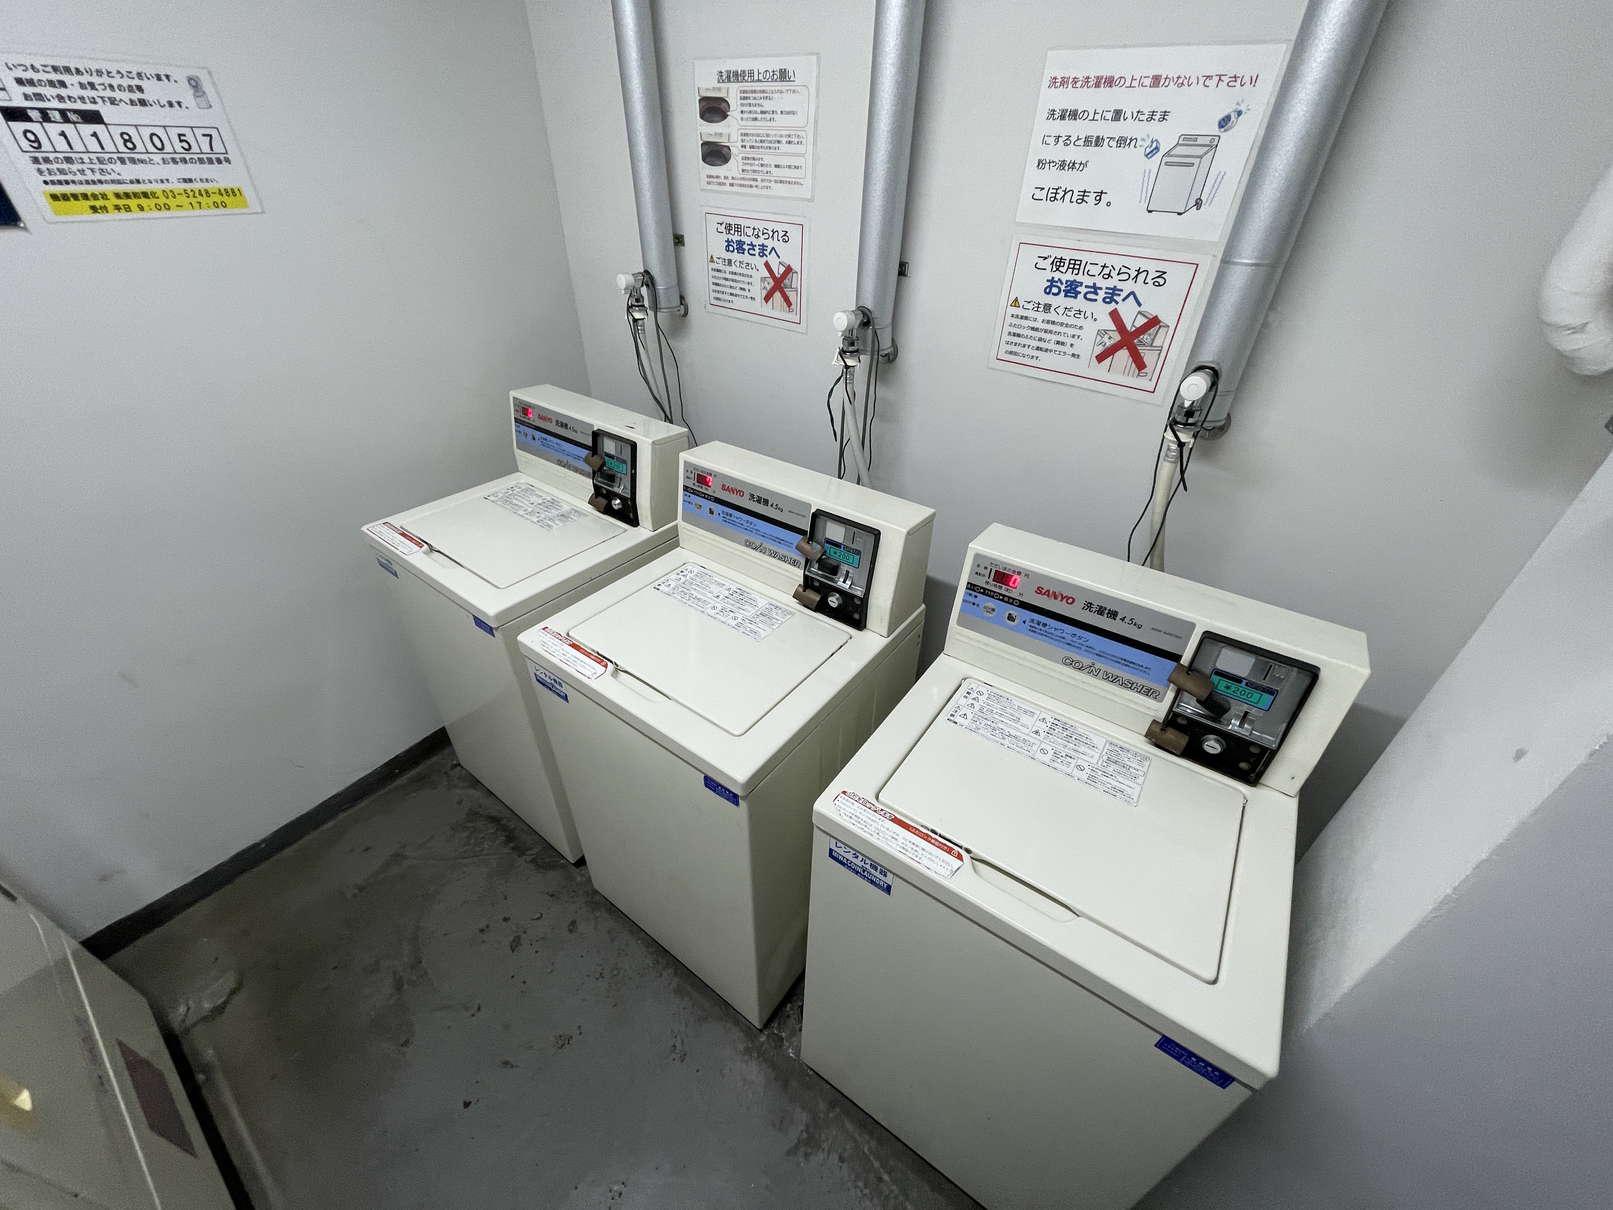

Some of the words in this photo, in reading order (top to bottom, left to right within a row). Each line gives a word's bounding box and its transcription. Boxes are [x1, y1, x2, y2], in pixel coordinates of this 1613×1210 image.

[5, 62, 180, 84] いつもご利用ありがとうございます。
[716, 67, 797, 82] 洗濯機使用上のお願い
[22, 92, 190, 110] お問い合わせは下記へお願いします。
[1045, 107, 1171, 123] 洗濯機の上に置いたまま
[1041, 133, 1139, 149] にすると振動で倒れ
[1036, 158, 1089, 172] 粉や液体が
[1031, 185, 1113, 208] こぼれます。
[716, 222, 790, 243] ご使用になられる
[724, 238, 781, 259] お客さまへ
[1034, 253, 1168, 288] ご使用になられる
[1043, 276, 1143, 308] お客さまへ
[1021, 299, 1100, 322] ご注意ください。
[720, 483, 745, 498] SANYO
[748, 493, 770, 508] 洗濯機
[1034, 585, 1077, 607] SANYO
[1081, 600, 1120, 621] 洗濯機
[1119, 615, 1144, 630] 4.5kg
[1102, 670, 1162, 700] WASHER
[834, 840, 889, 878] レンタル機器
